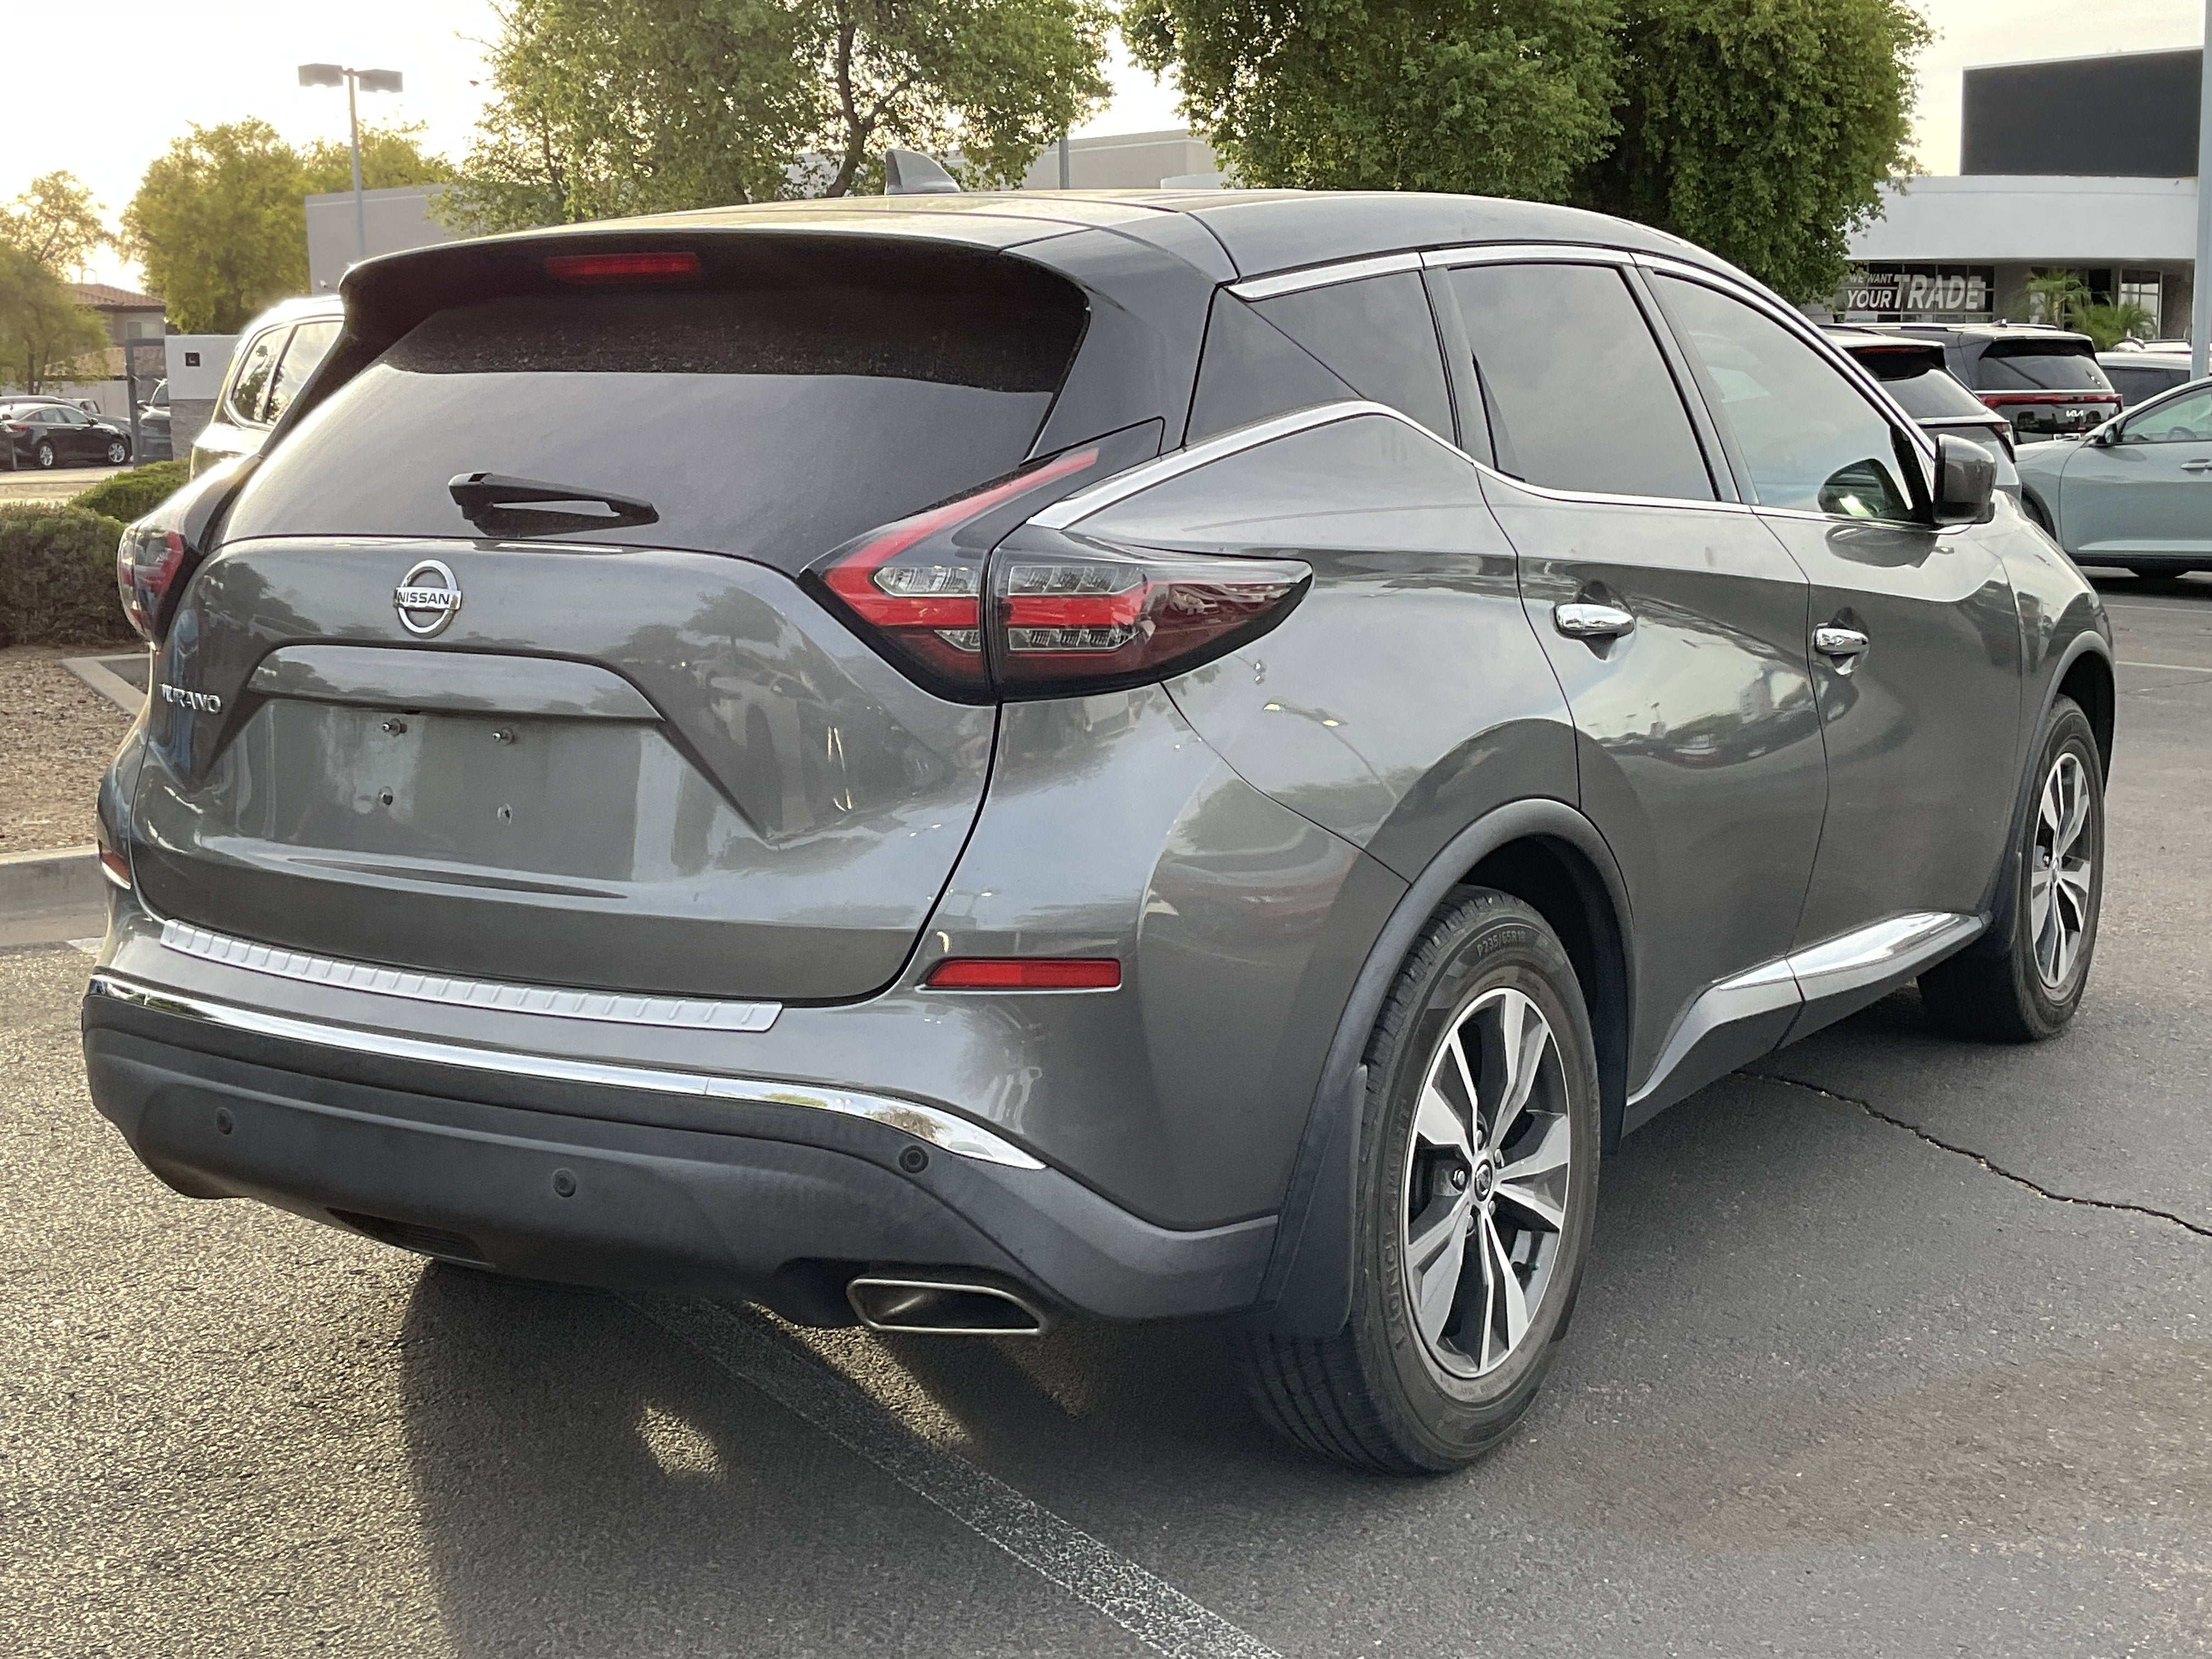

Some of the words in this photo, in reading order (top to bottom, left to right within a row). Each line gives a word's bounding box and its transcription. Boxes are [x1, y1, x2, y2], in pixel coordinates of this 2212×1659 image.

[1849, 273, 1864, 283] WE
[1867, 273, 1893, 283] WANT
[1847, 290, 1892, 308] YOUR
[1893, 274, 1982, 309] TRADE
[397, 591, 450, 605] NISSAN
